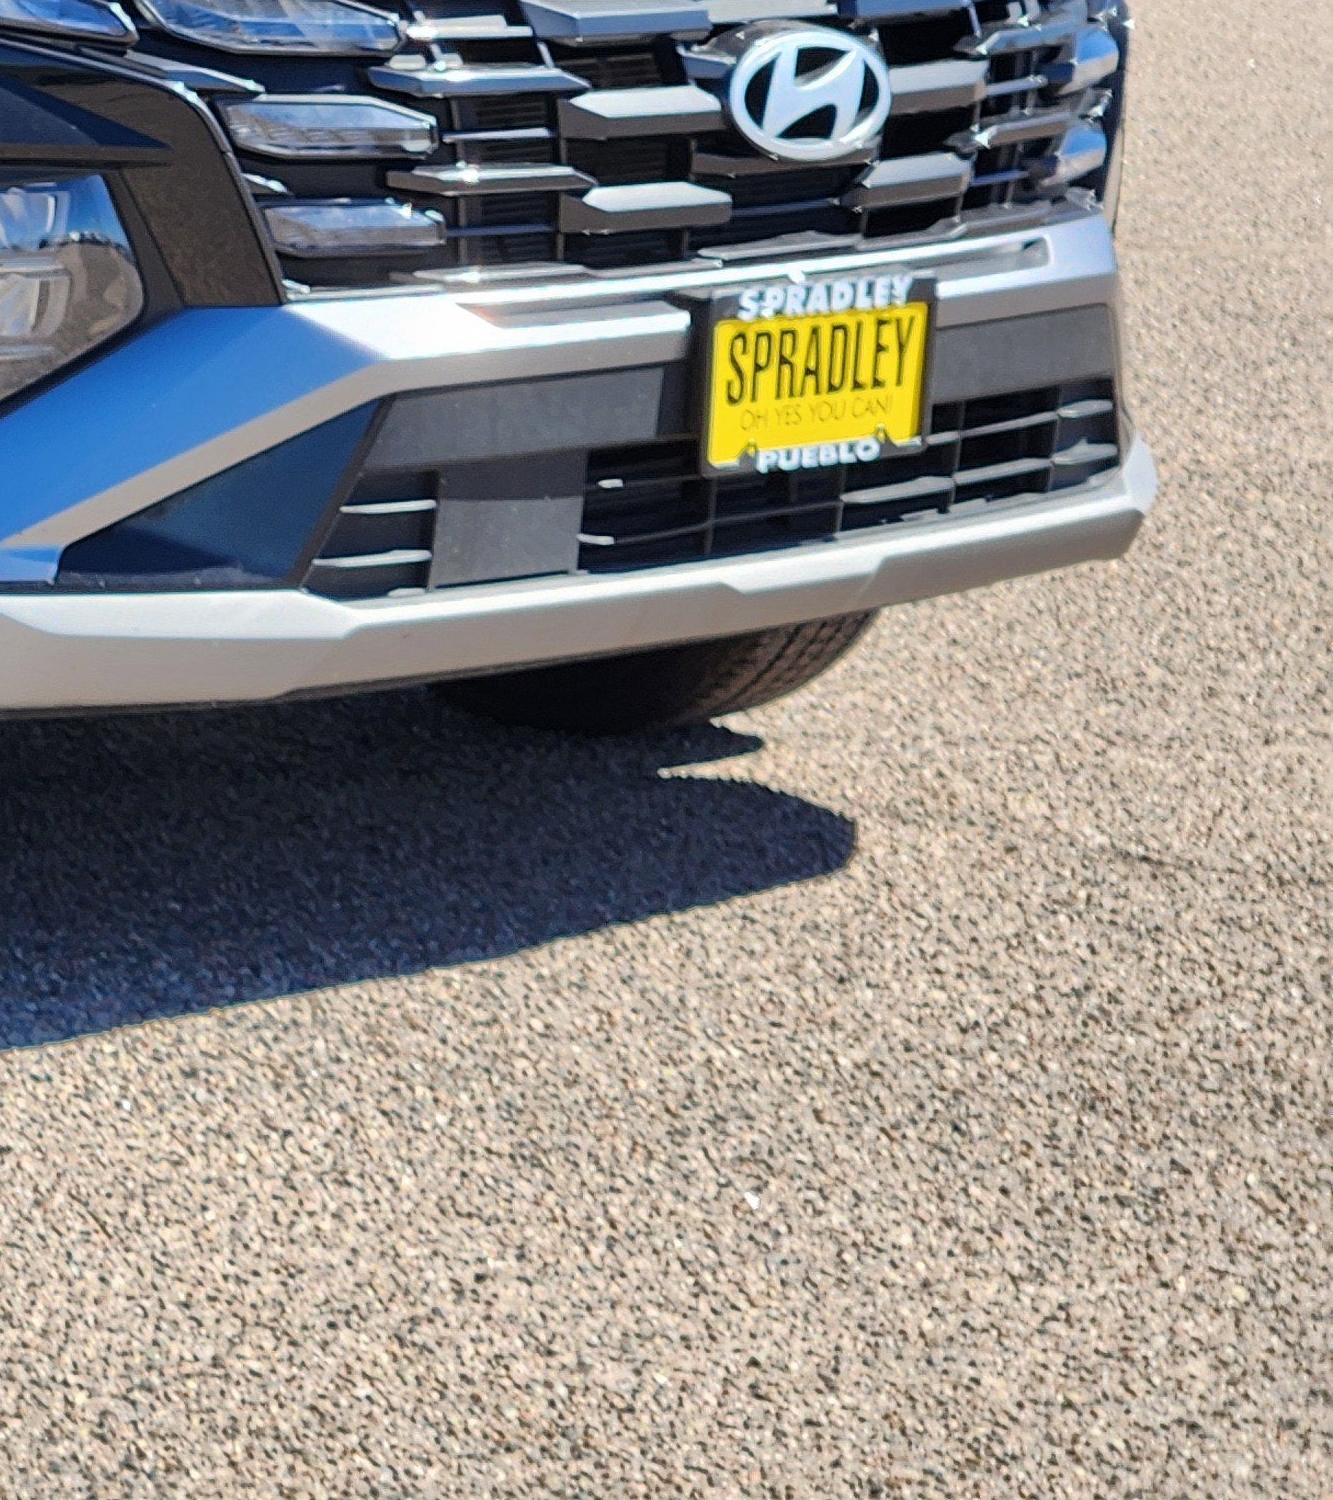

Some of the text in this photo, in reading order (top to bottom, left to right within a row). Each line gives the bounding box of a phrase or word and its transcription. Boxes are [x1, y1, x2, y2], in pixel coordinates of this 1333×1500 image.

[737, 275, 913, 321] SPRADLEY
[726, 315, 916, 406] SPRADLEY
[740, 409, 769, 430] OH
[775, 404, 803, 426] YES
[808, 399, 847, 422] YOU
[755, 436, 881, 474] PUEBLO
